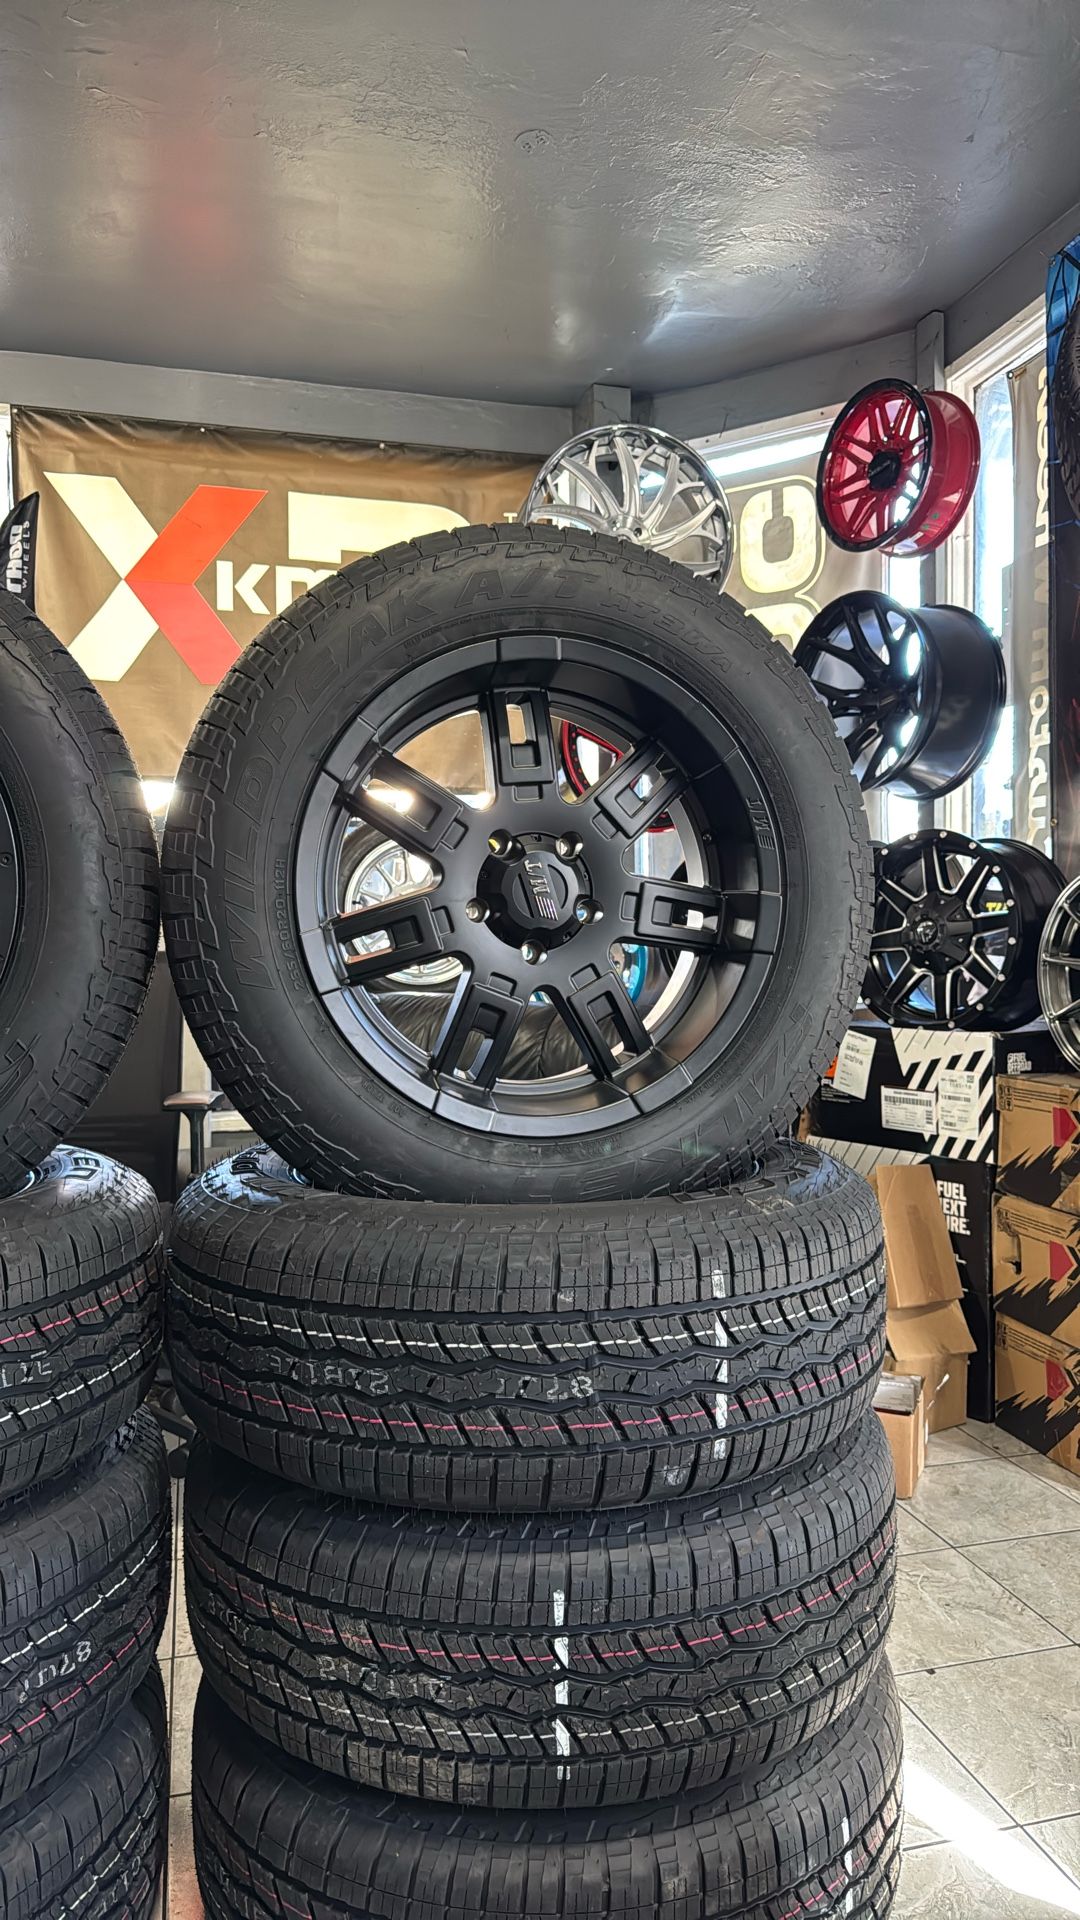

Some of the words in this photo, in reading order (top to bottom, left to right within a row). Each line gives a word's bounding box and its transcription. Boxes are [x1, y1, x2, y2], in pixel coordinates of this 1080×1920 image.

[22, 521, 31, 589] WHEELS
[224, 590, 438, 992] WILDPEAK
[273, 858, 287, 891] 112H
[524, 859, 551, 897] M/T
[274, 898, 305, 991] 265/60R20
[936, 1180, 967, 1200] FUEL
[939, 1197, 967, 1217] EXT
